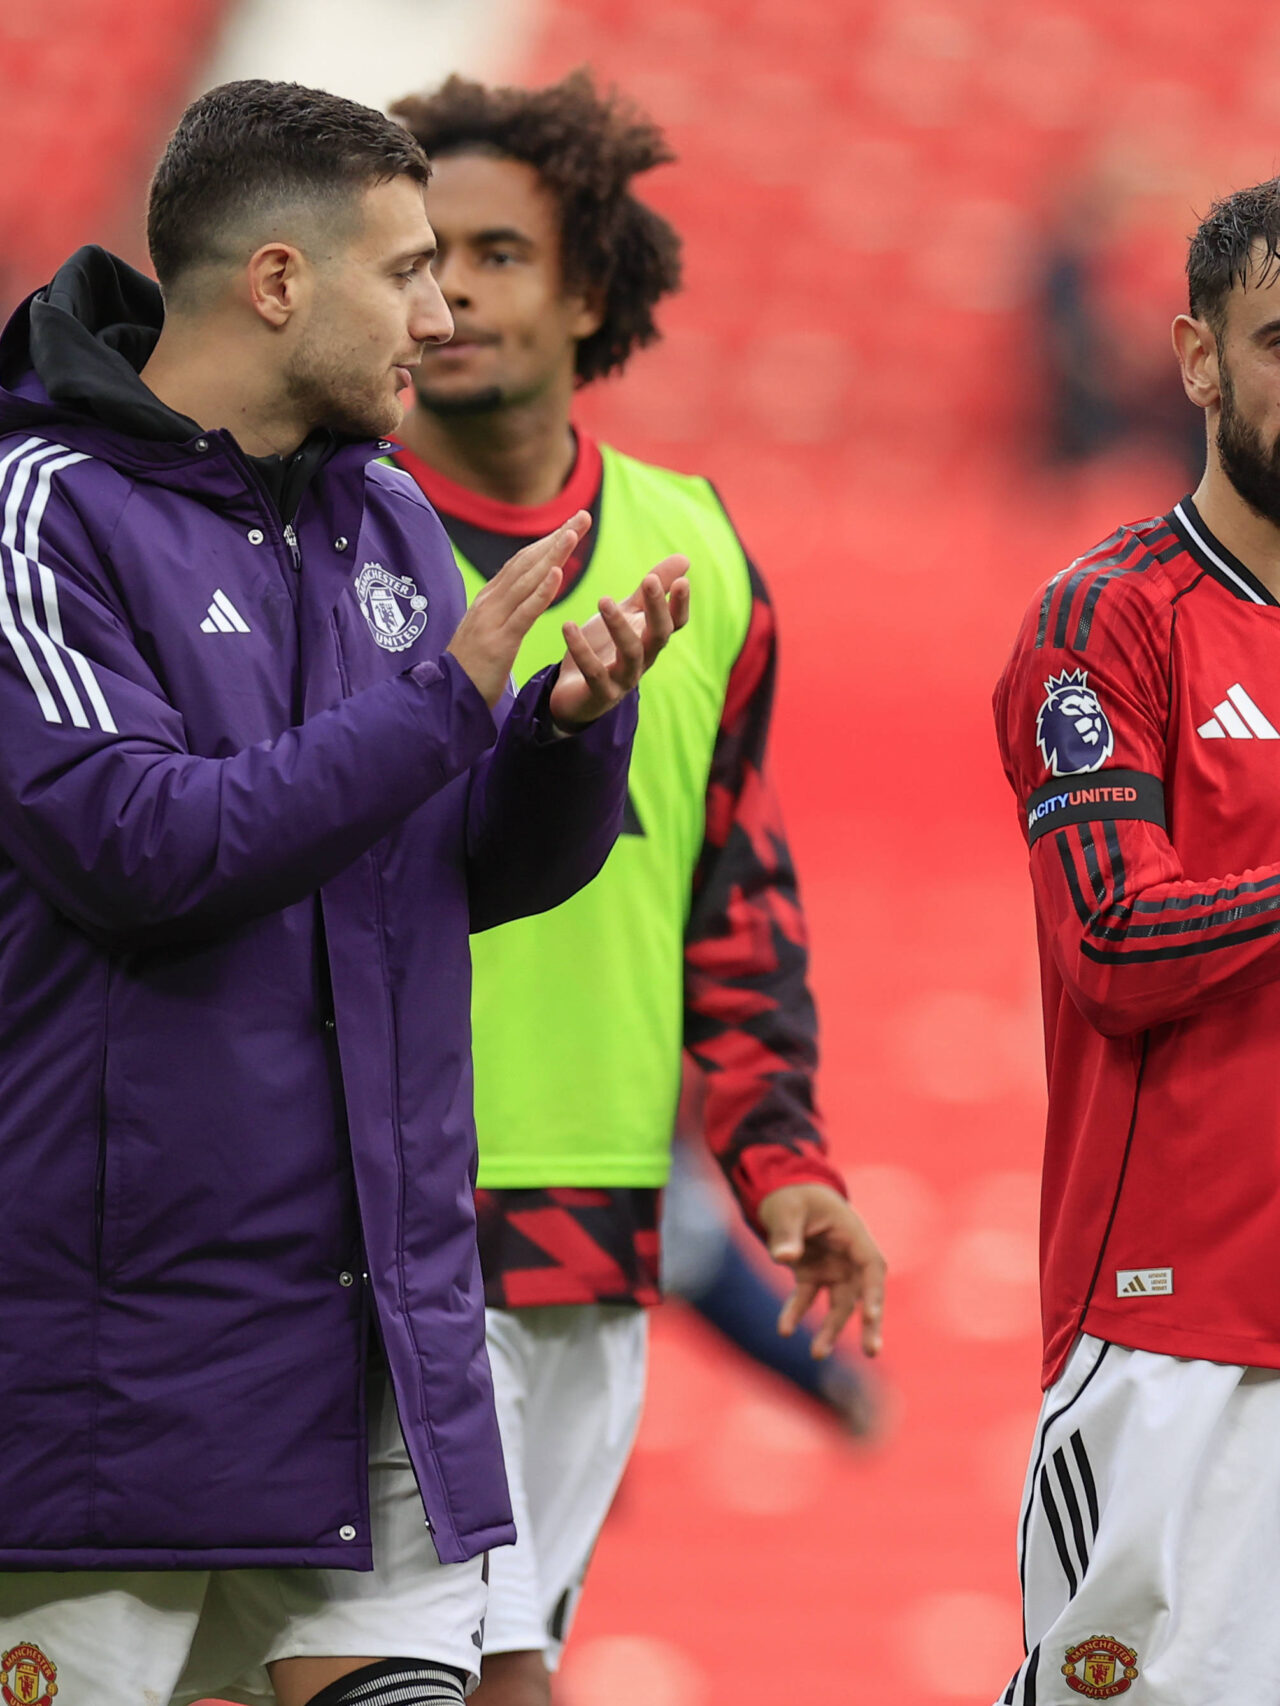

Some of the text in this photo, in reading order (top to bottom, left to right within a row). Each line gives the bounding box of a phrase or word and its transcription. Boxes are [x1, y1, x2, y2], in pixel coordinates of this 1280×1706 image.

[359, 569, 410, 596] MANCHESTER
[376, 625, 420, 646] UNITED
[1071, 1640, 1131, 1663] MANCHESTER
[1077, 1683, 1120, 1696] UNITED
